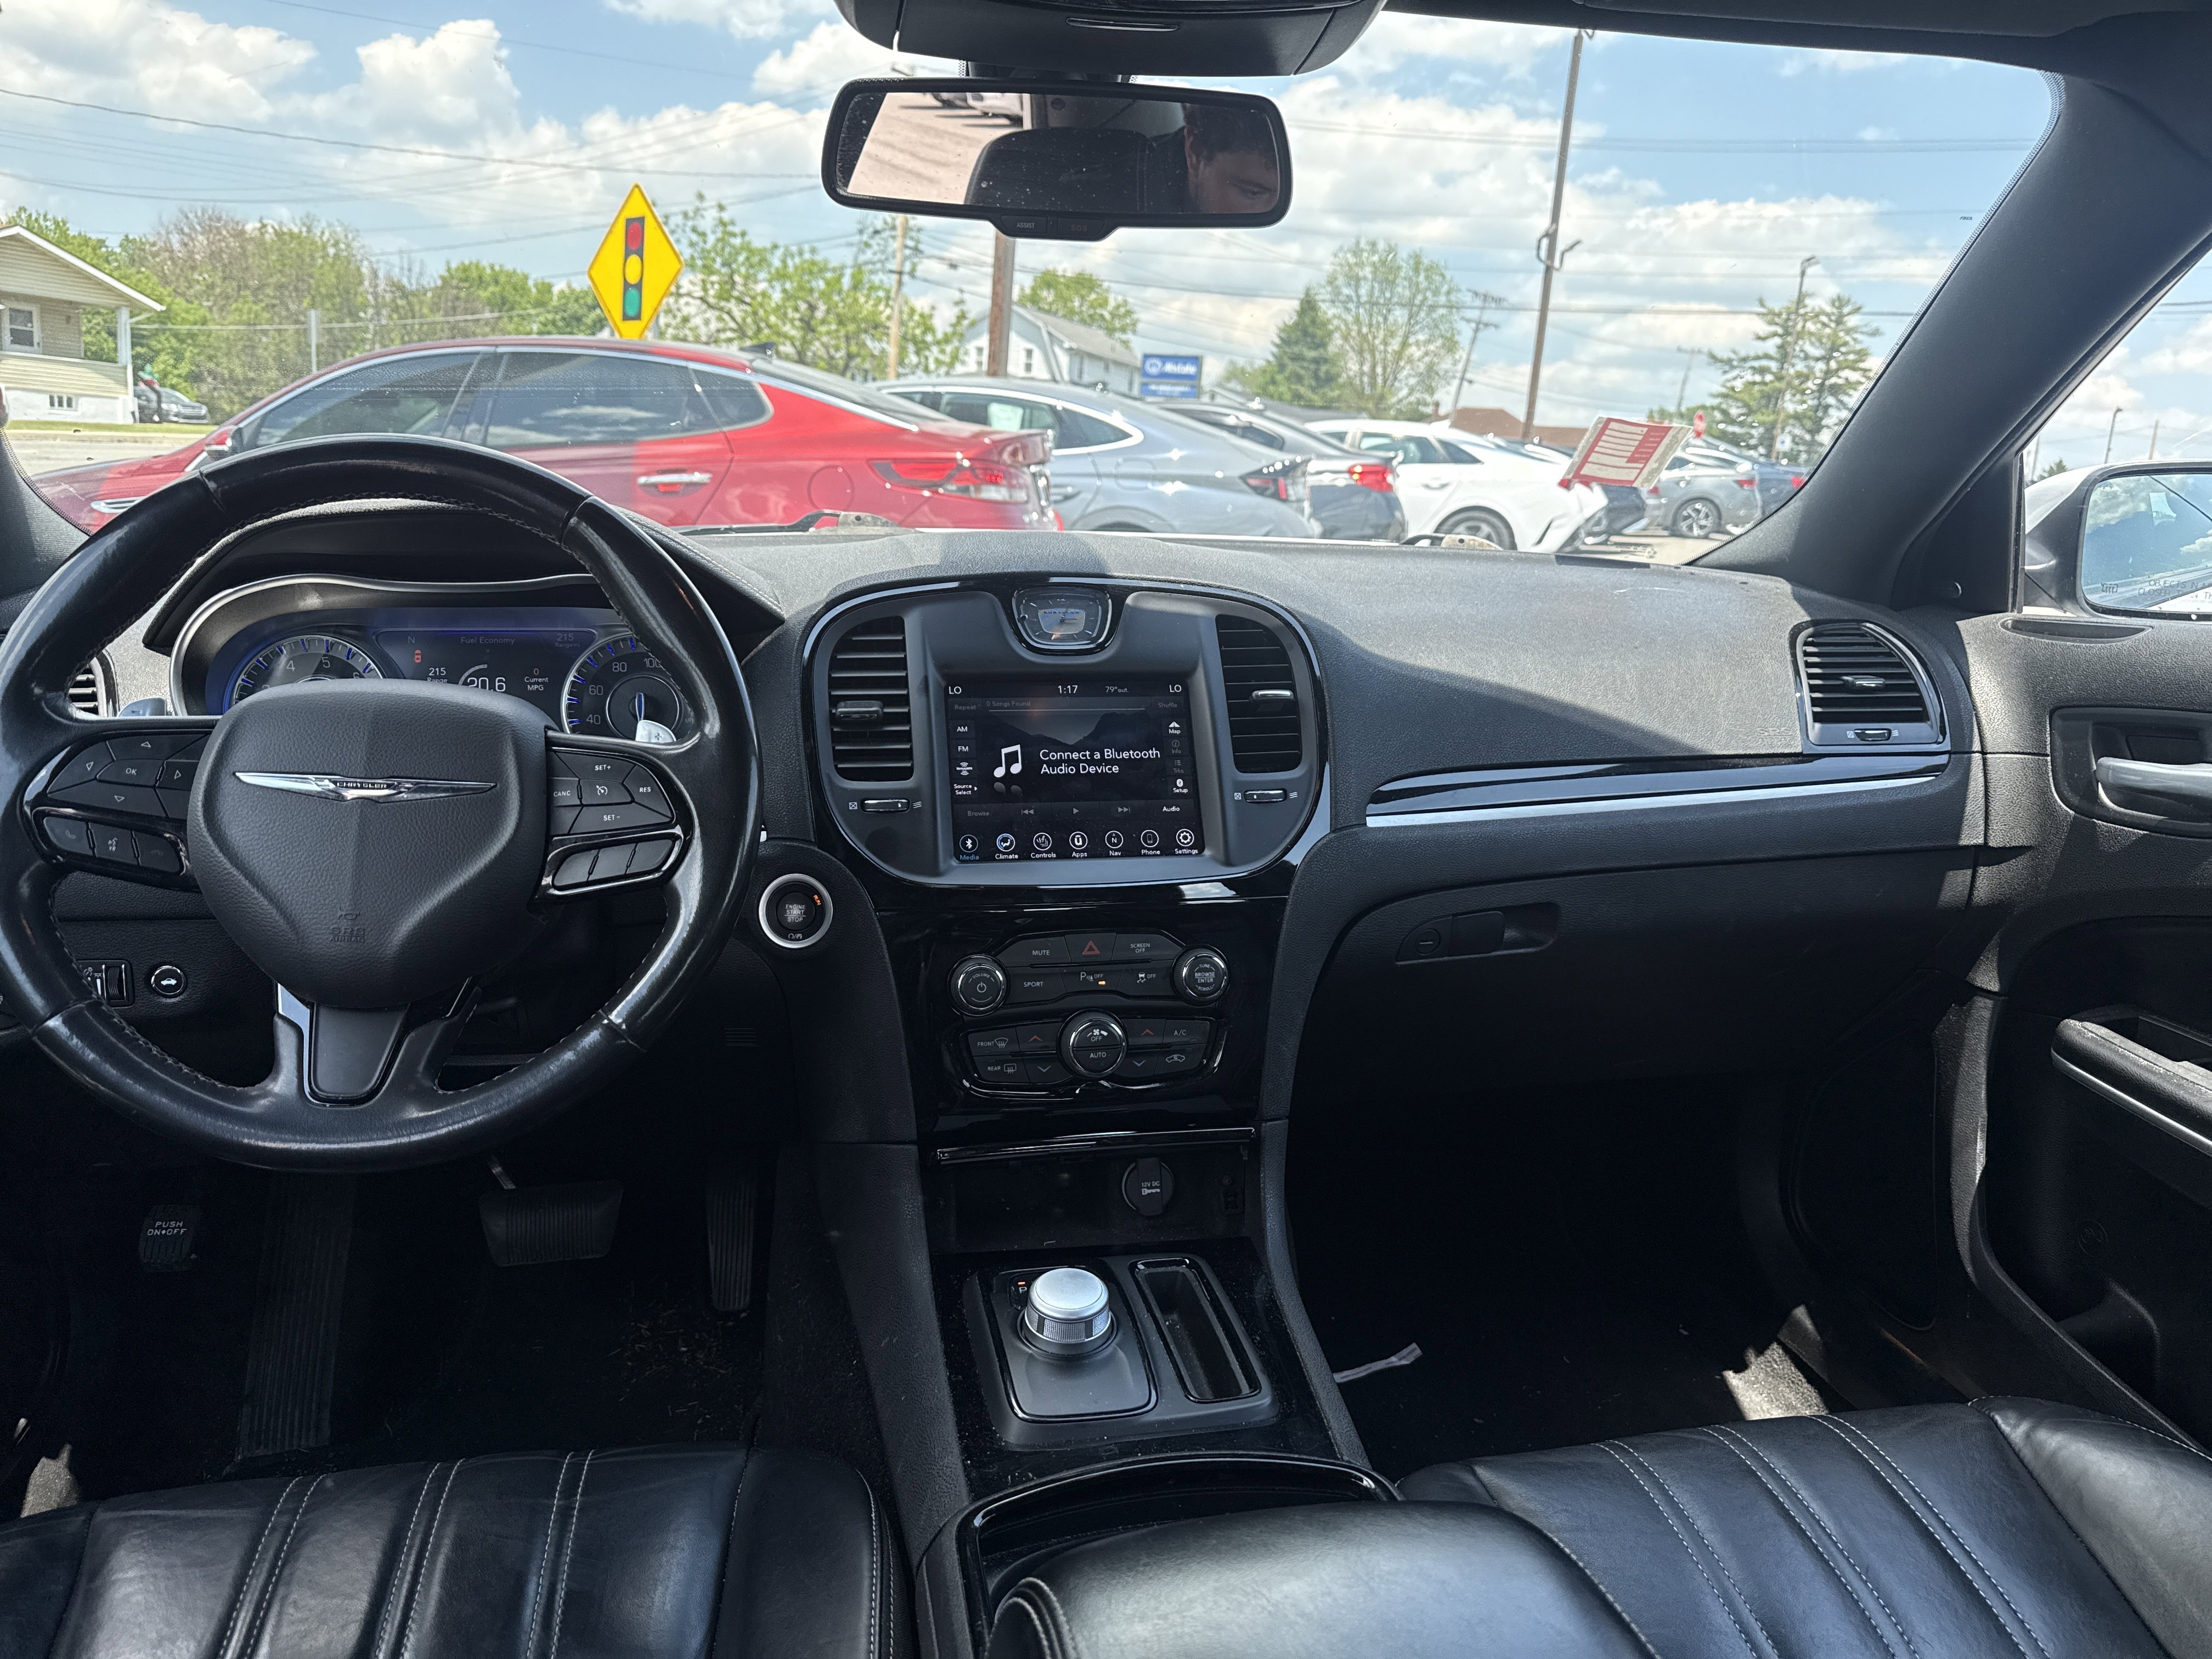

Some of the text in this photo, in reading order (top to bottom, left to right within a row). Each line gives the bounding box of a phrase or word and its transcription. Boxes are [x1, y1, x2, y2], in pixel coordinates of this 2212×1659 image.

[2149, 579, 2186, 588] OBJECTS
[2138, 588, 2170, 597] CLOSER
[479, 636, 516, 645] Economy
[286, 661, 295, 672] 4
[322, 657, 330, 668] 5
[612, 662, 627, 672] 80
[429, 668, 445, 676] 215
[467, 677, 506, 692] 20.6
[1058, 685, 1078, 694] 1:17
[589, 685, 603, 695] 60
[949, 686, 961, 695] LO
[586, 714, 600, 724] 40
[1040, 749, 1091, 760] Connect
[1104, 747, 1160, 759] Bluetooth
[1041, 763, 1119, 775] Audio Device
[813, 894, 822, 905] RUN
